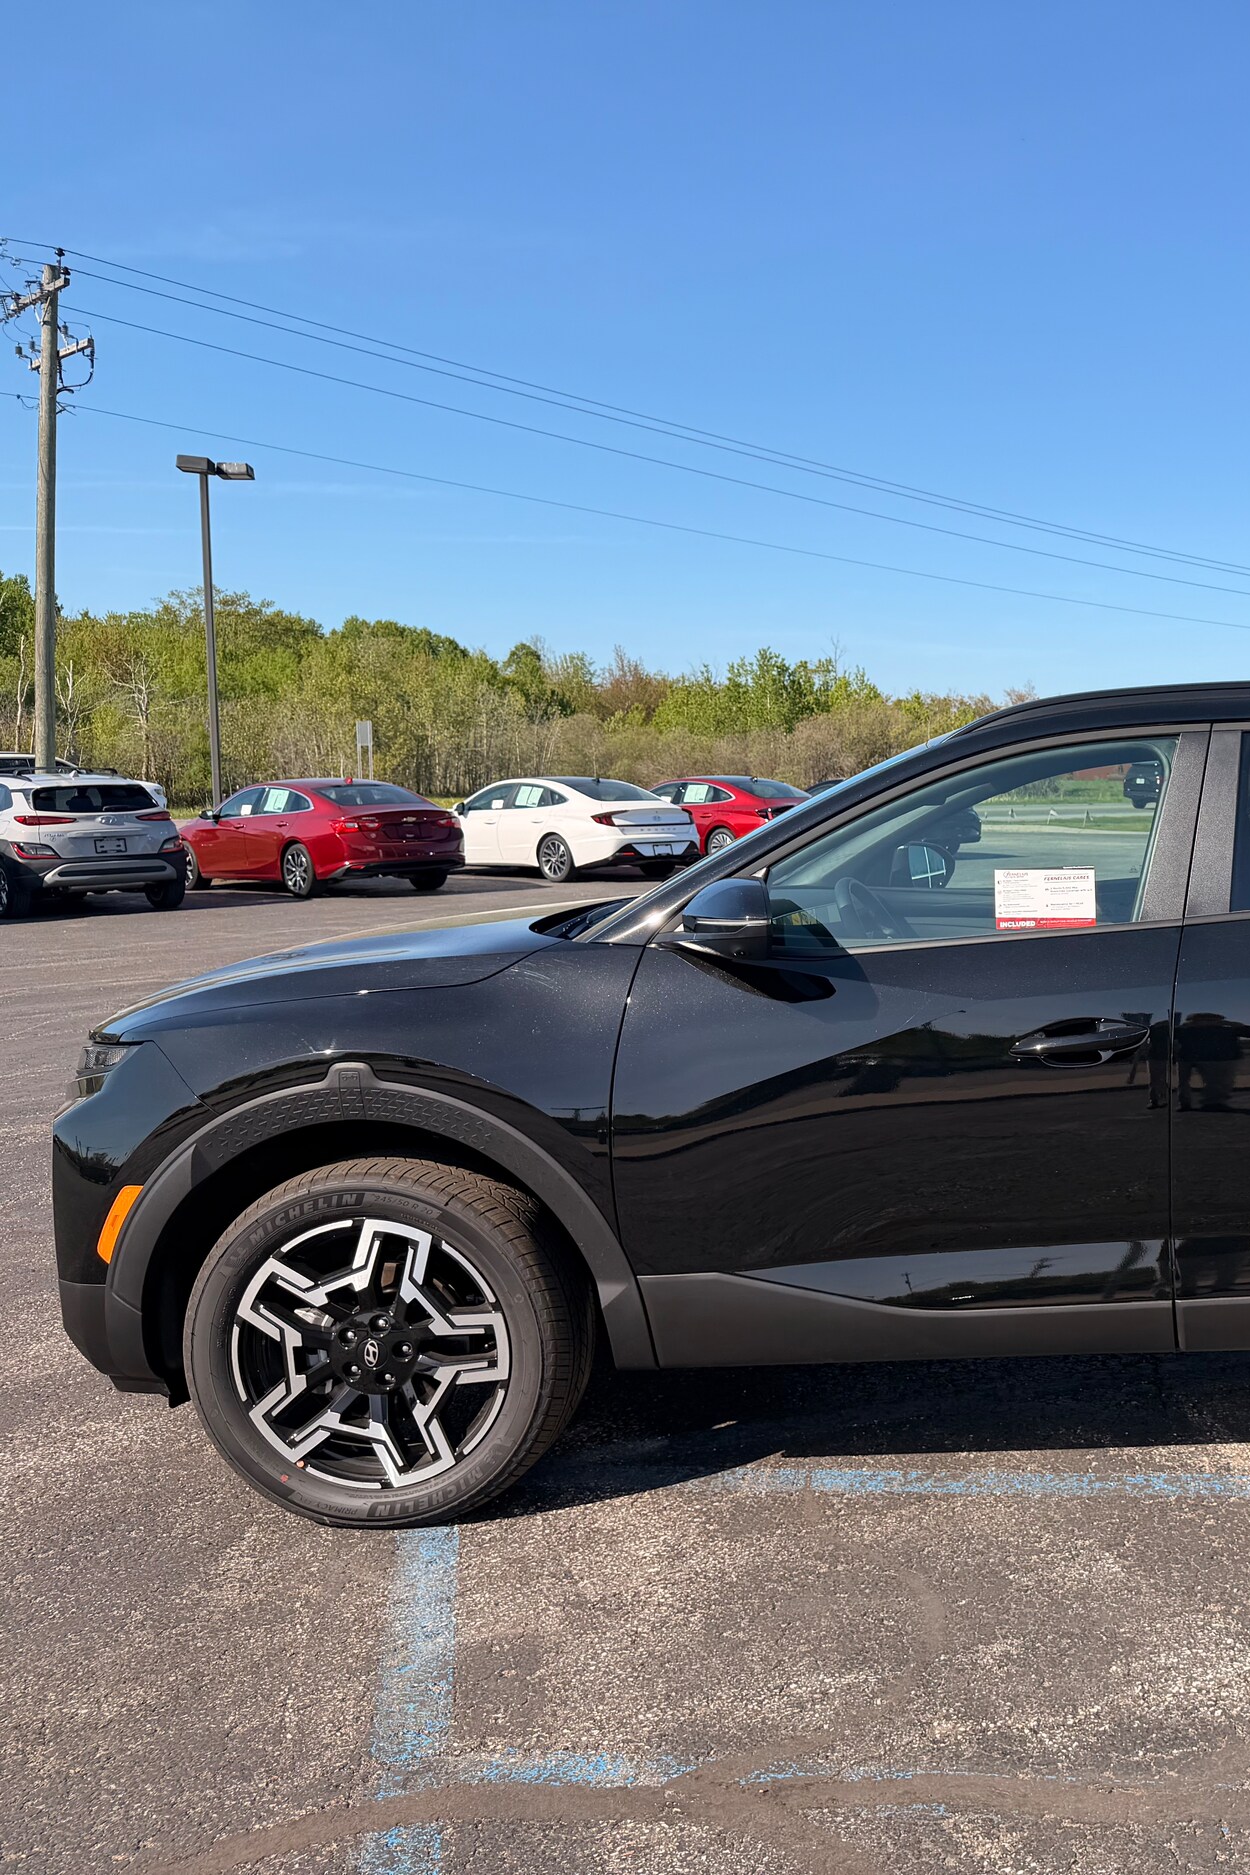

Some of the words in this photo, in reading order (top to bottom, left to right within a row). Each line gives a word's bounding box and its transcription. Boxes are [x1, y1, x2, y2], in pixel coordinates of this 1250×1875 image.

[1000, 920, 1036, 928] INCLUDED
[249, 1193, 357, 1243] MICHELIN
[375, 1467, 483, 1517] MICHELIN
